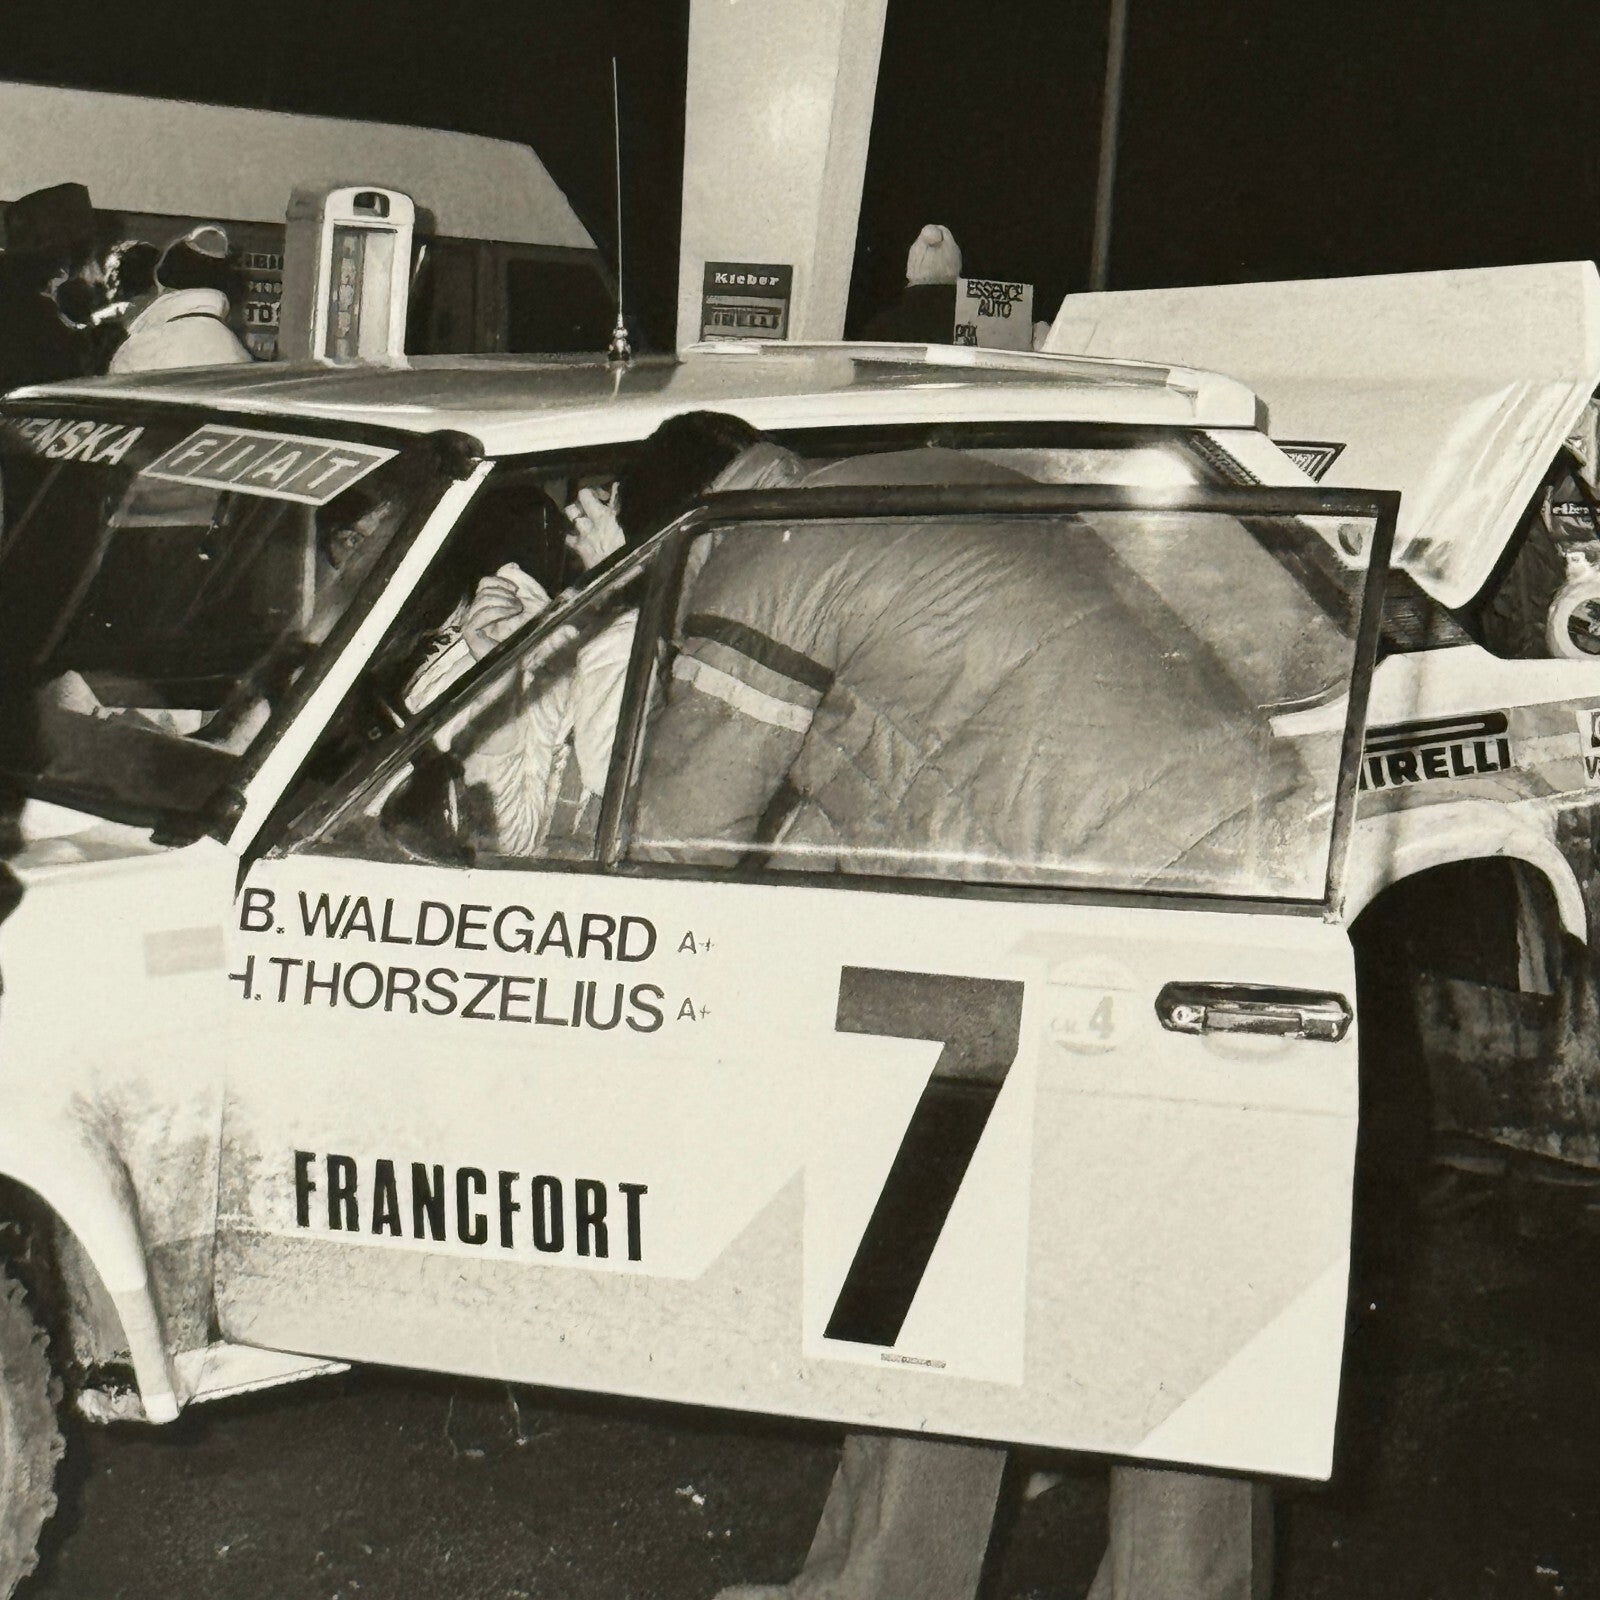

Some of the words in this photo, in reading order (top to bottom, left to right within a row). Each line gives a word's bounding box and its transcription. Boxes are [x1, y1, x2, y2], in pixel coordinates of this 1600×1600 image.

[978, 298, 1012, 318] AUTO
[168, 438, 360, 490] FIAT
[239, 887, 285, 934] B.
[298, 890, 657, 963] WALDEGARD
[823, 965, 1025, 1347] 7
[295, 1150, 649, 1261] FRANCFORT
